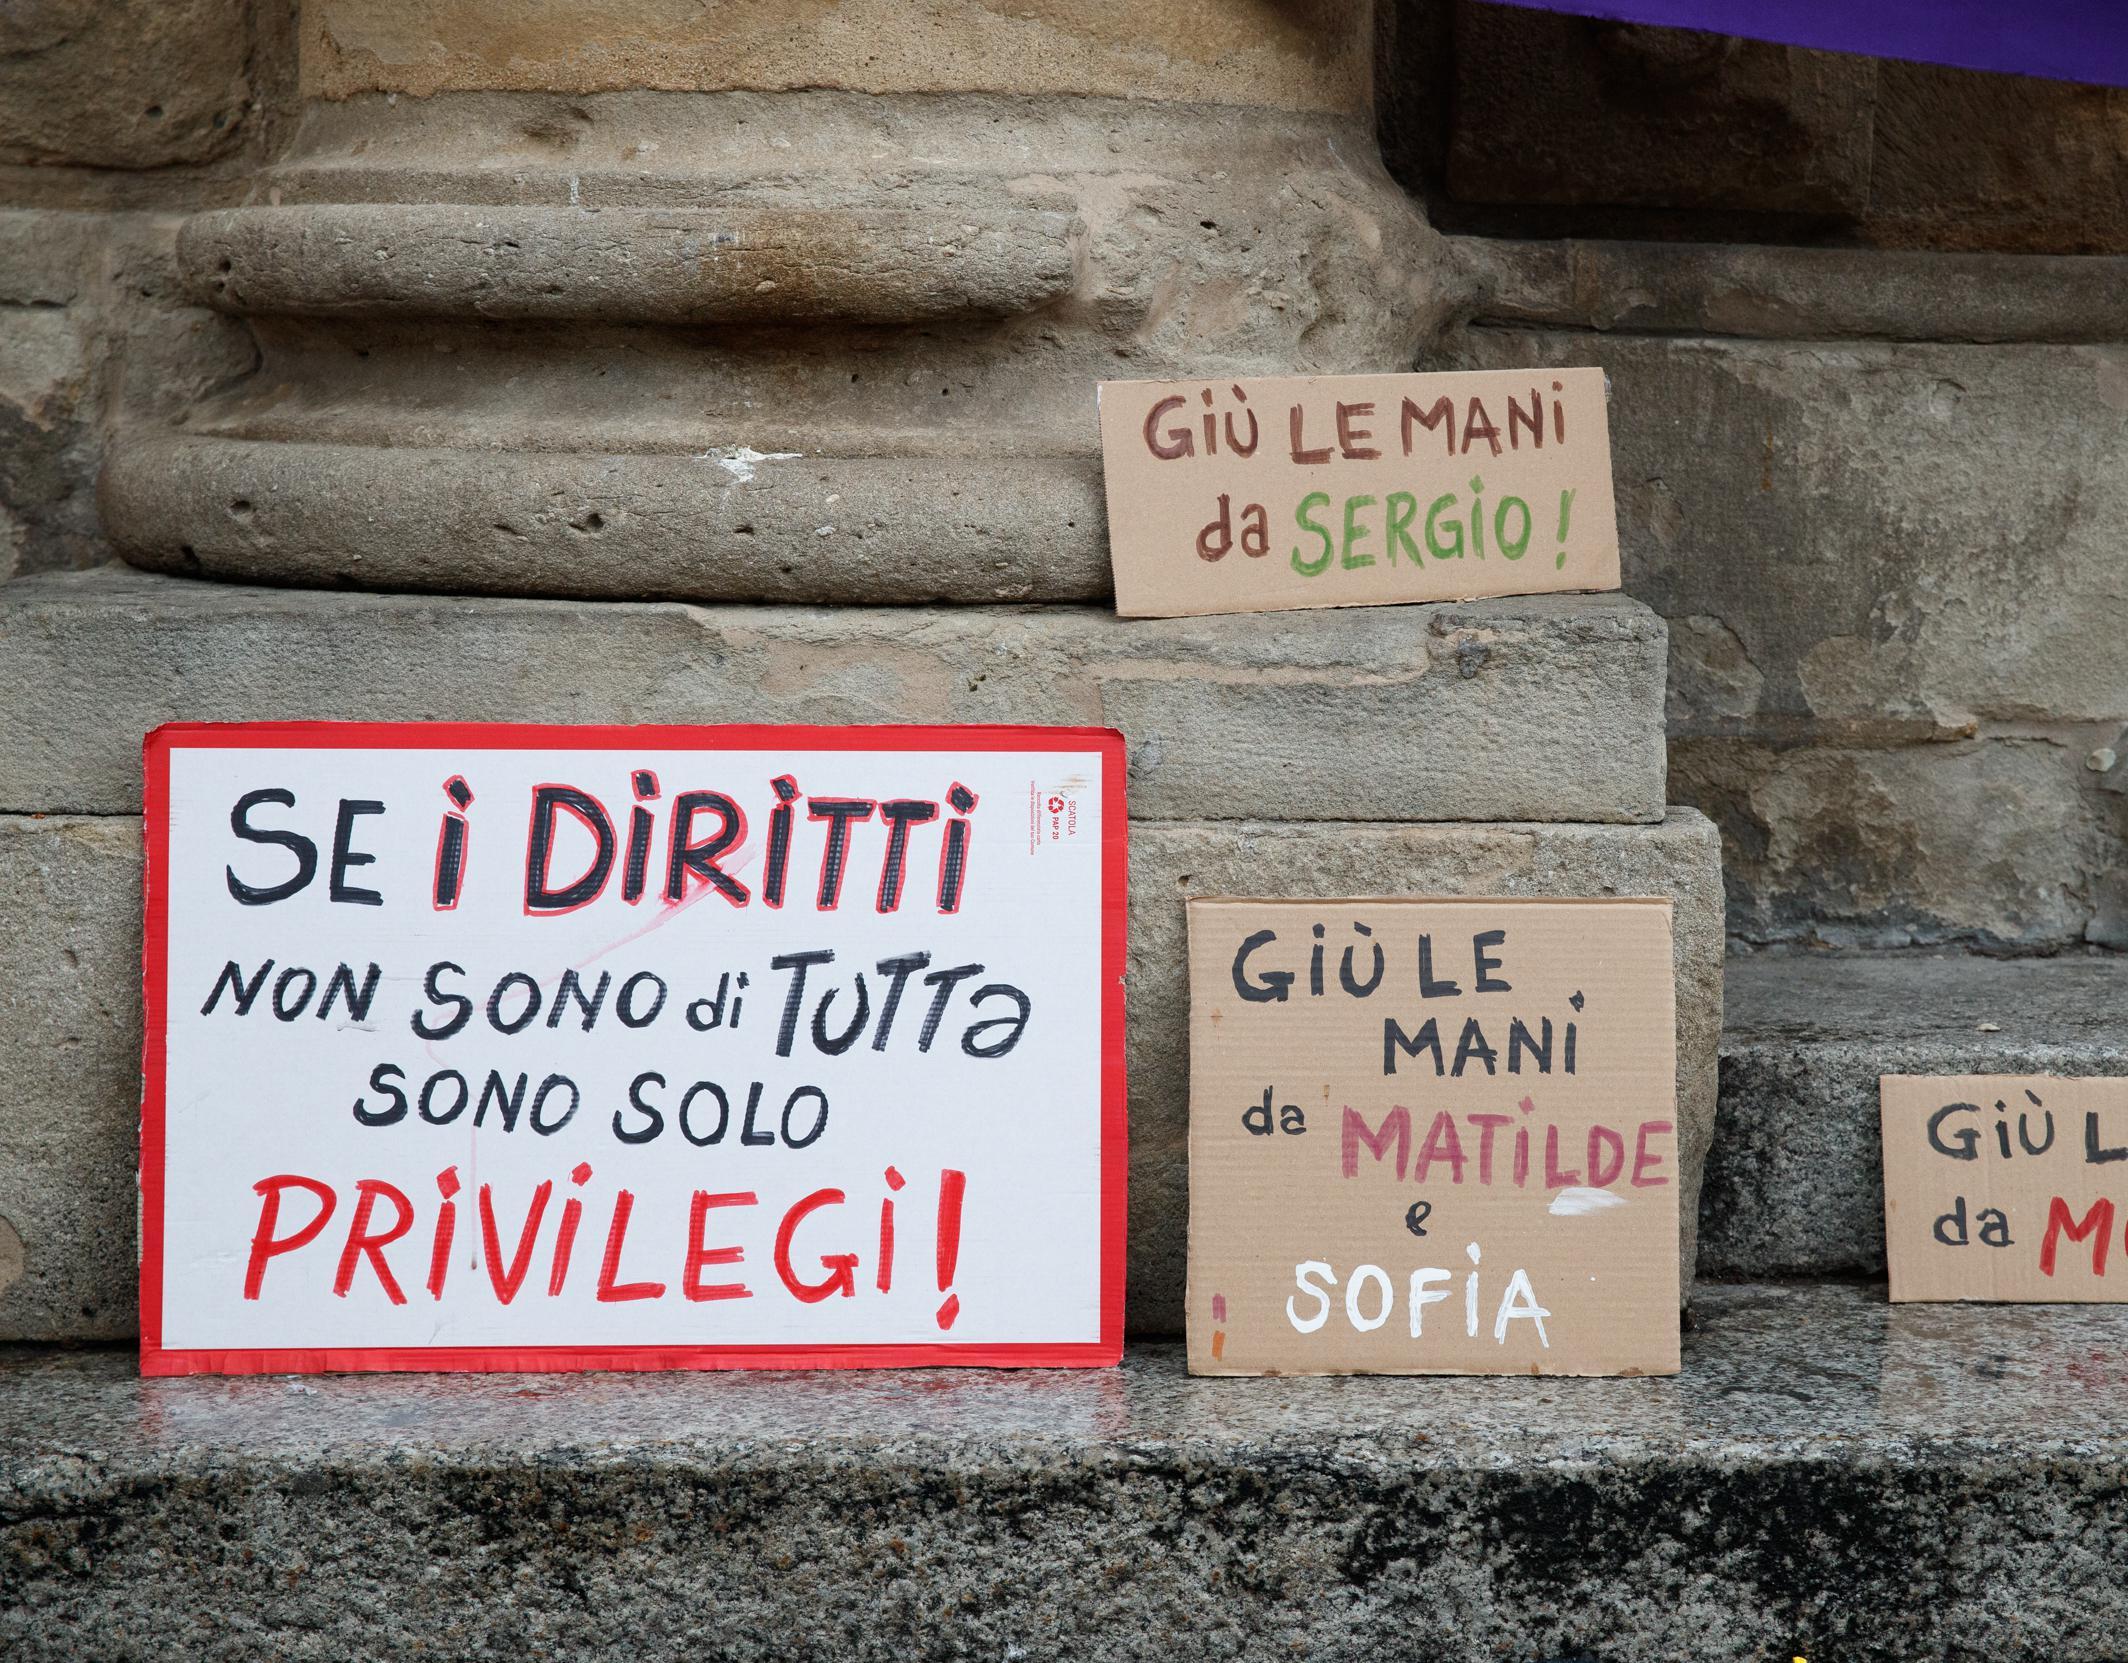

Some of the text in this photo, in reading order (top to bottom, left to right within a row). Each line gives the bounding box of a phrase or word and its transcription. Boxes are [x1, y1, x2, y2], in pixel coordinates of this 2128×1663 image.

[1290, 400, 1383, 465] LE
[1195, 493, 1270, 563] da
[226, 787, 386, 906] SE
[1052, 816, 1060, 840] PAP 20
[1068, 800, 1077, 836] SCATOLA
[1417, 929, 1512, 999] LE
[200, 959, 383, 1023] NON
[410, 960, 668, 1041] SONO
[686, 971, 750, 1032] di
[352, 1062, 829, 1149] SONO SOLO
[1240, 1085, 1307, 1136] da
[1405, 1200, 1432, 1236] e
[1933, 1195, 2128, 1277] da M
